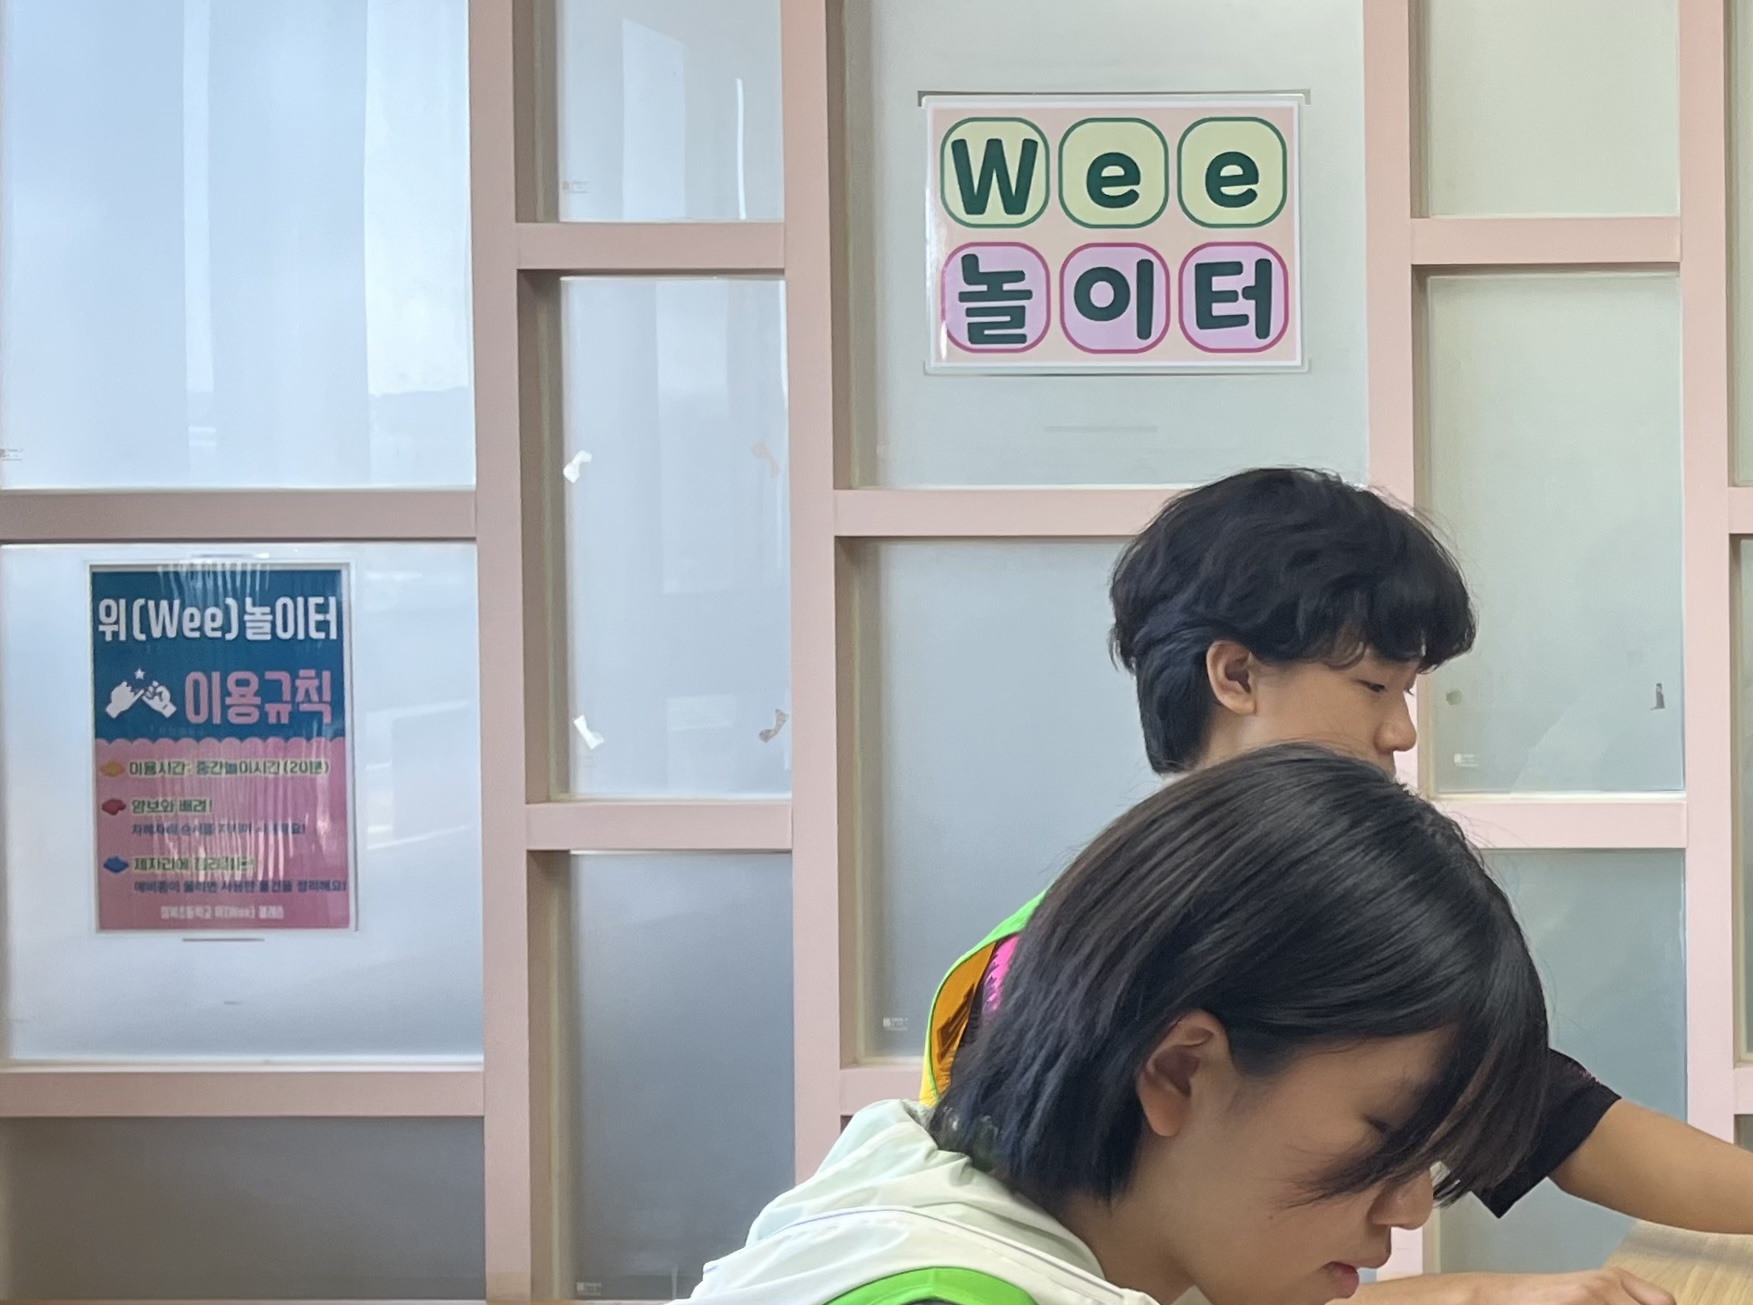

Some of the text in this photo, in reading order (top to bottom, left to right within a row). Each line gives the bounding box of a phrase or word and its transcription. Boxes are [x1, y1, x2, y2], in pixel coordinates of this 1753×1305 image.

[952, 138, 1259, 215] Wee
[958, 254, 1273, 344] 놀이터
[185, 670, 332, 724] 이용규칙
